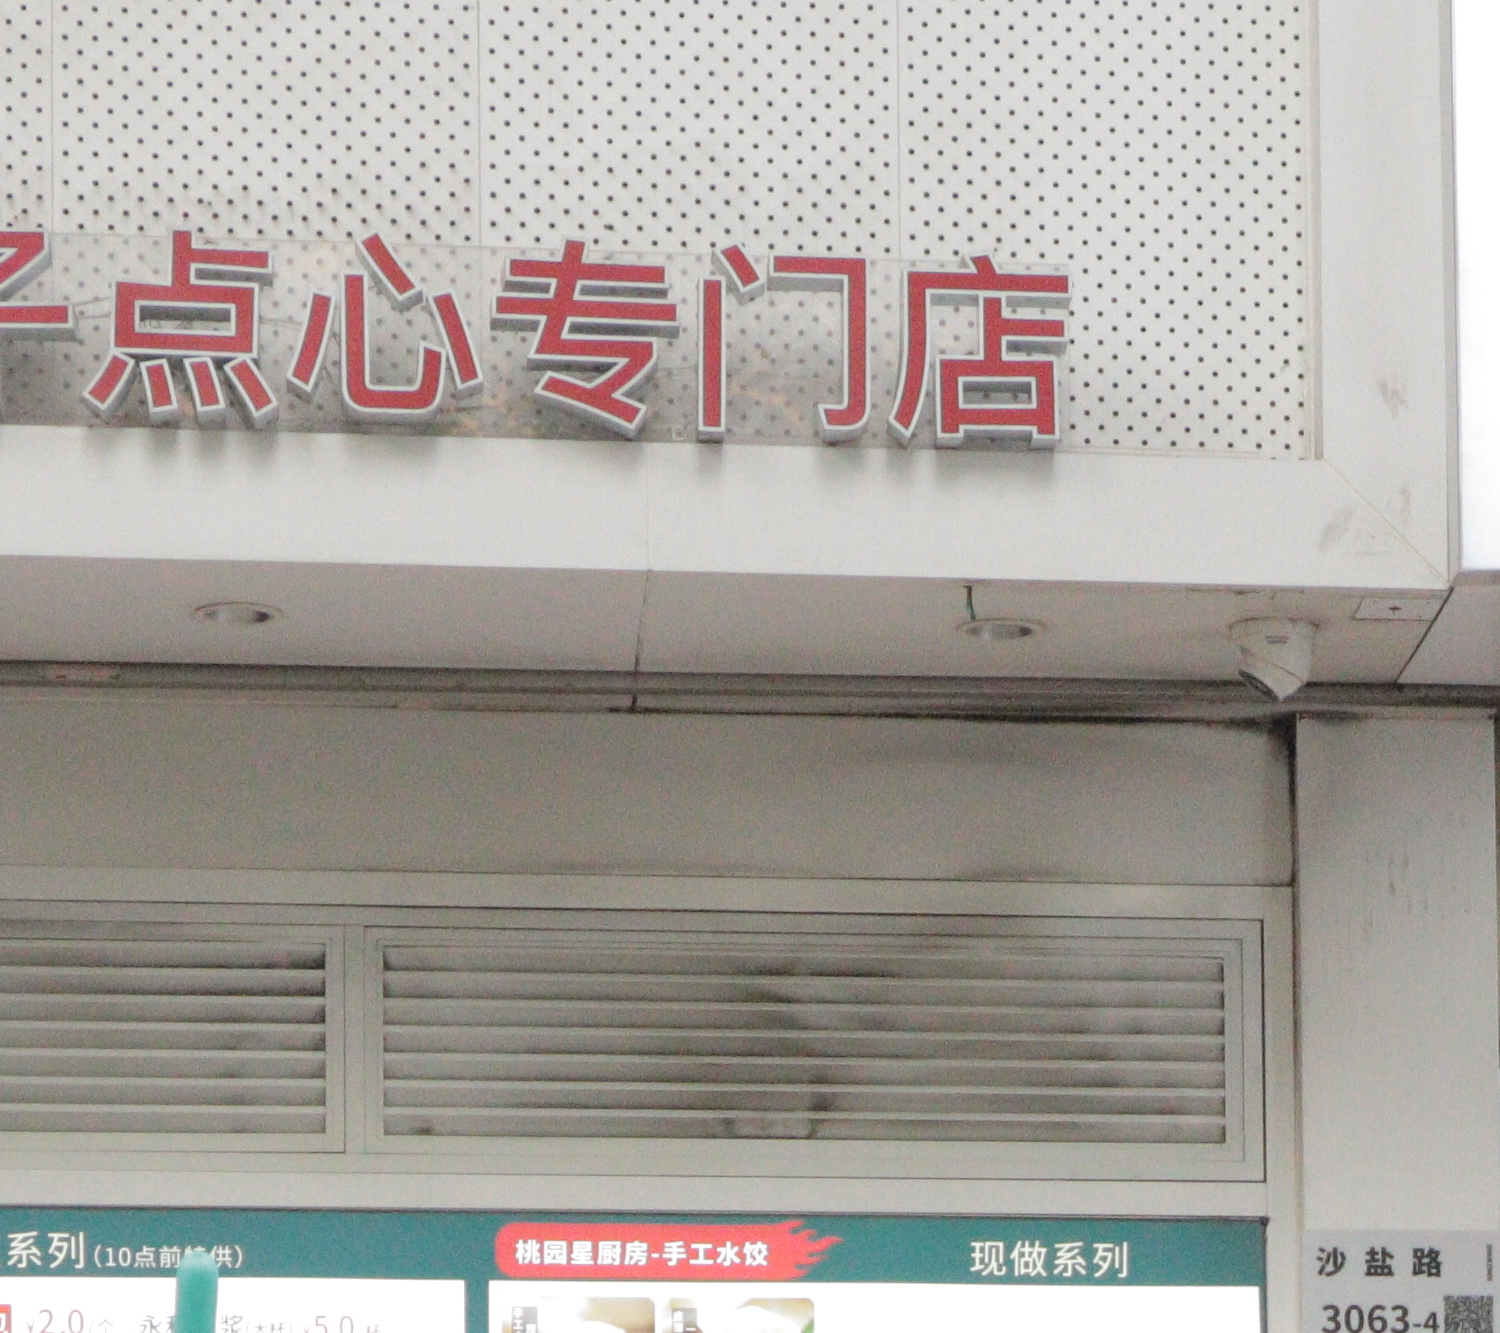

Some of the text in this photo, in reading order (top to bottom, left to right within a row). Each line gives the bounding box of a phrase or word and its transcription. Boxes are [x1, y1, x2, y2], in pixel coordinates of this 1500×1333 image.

[515, 1240, 769, 1266] 桃园星厨房-手工水饺
[969, 1241, 1130, 1279] 现做系列
[1316, 1247, 1443, 1278] 沙盐路
